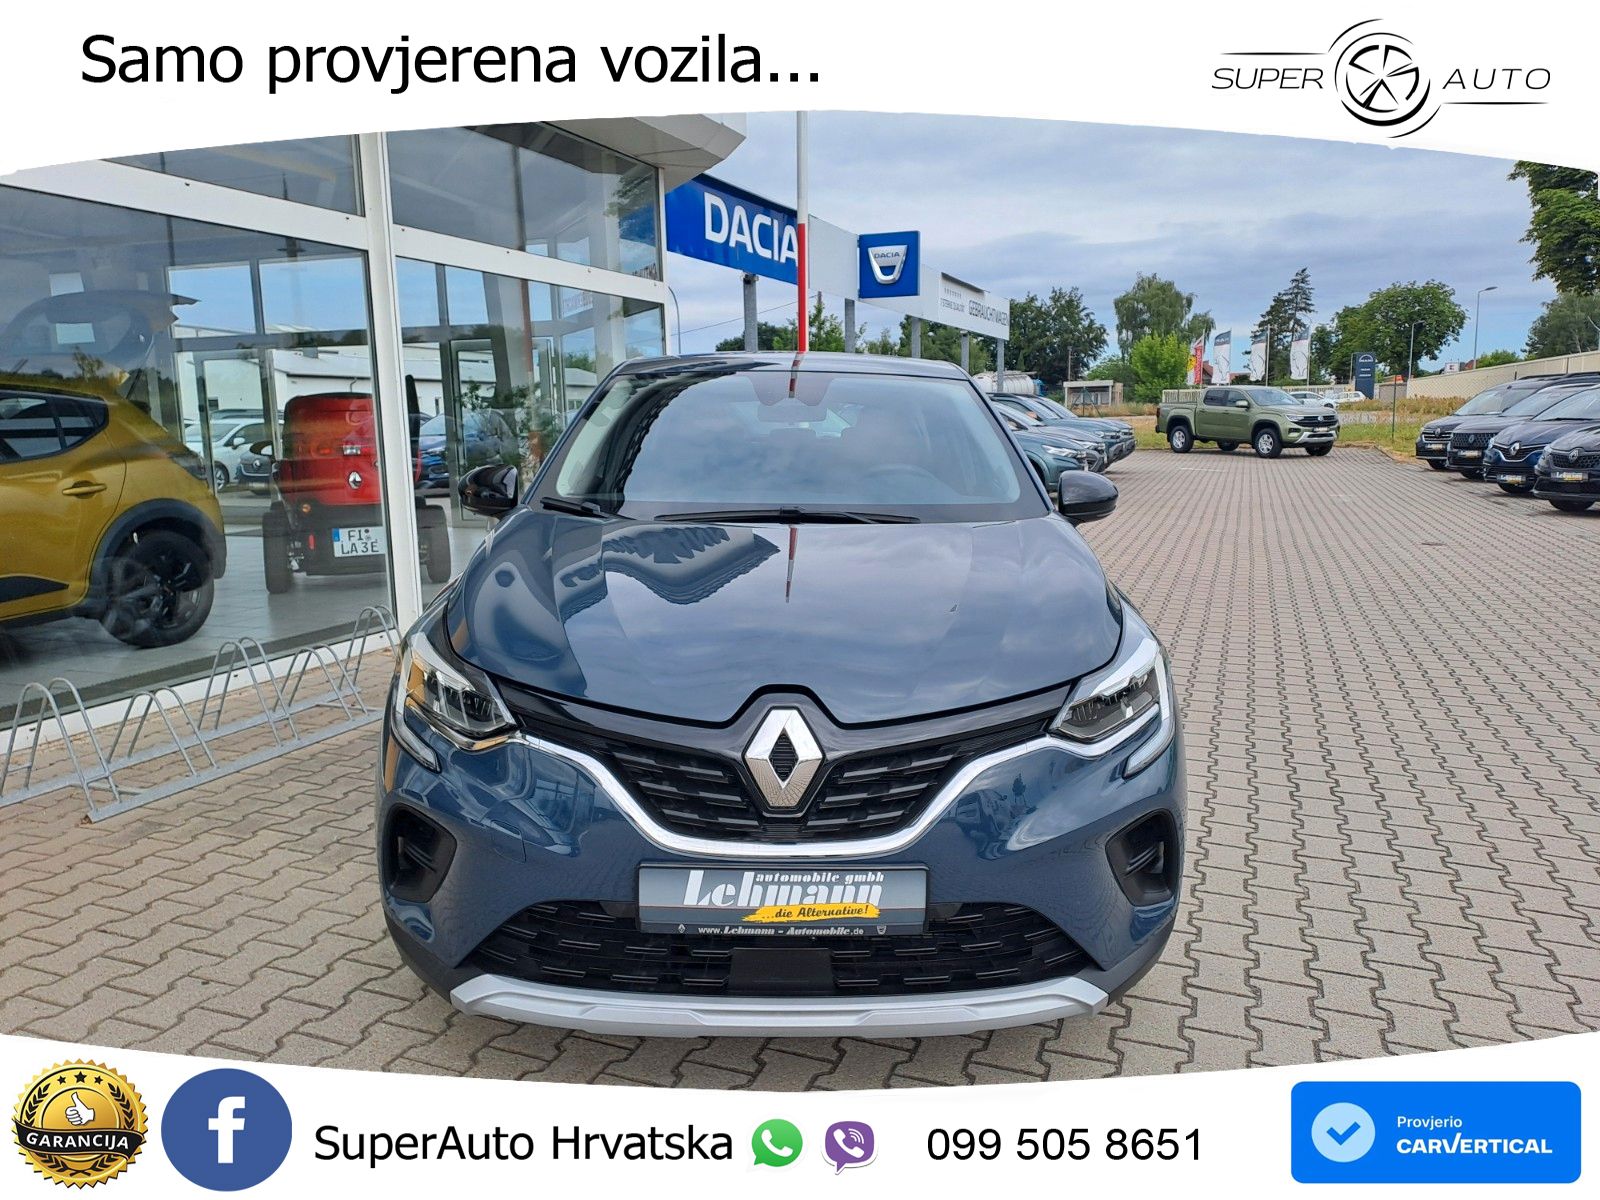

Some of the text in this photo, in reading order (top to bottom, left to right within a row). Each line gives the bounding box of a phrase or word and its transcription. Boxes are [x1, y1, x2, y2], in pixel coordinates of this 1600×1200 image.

[704, 191, 799, 267] DACIA
[874, 251, 900, 259] DACIA
[755, 872, 884, 884] automobile gmbh
[683, 870, 882, 907] Lehmann
[797, 905, 869, 917] Alternative!
